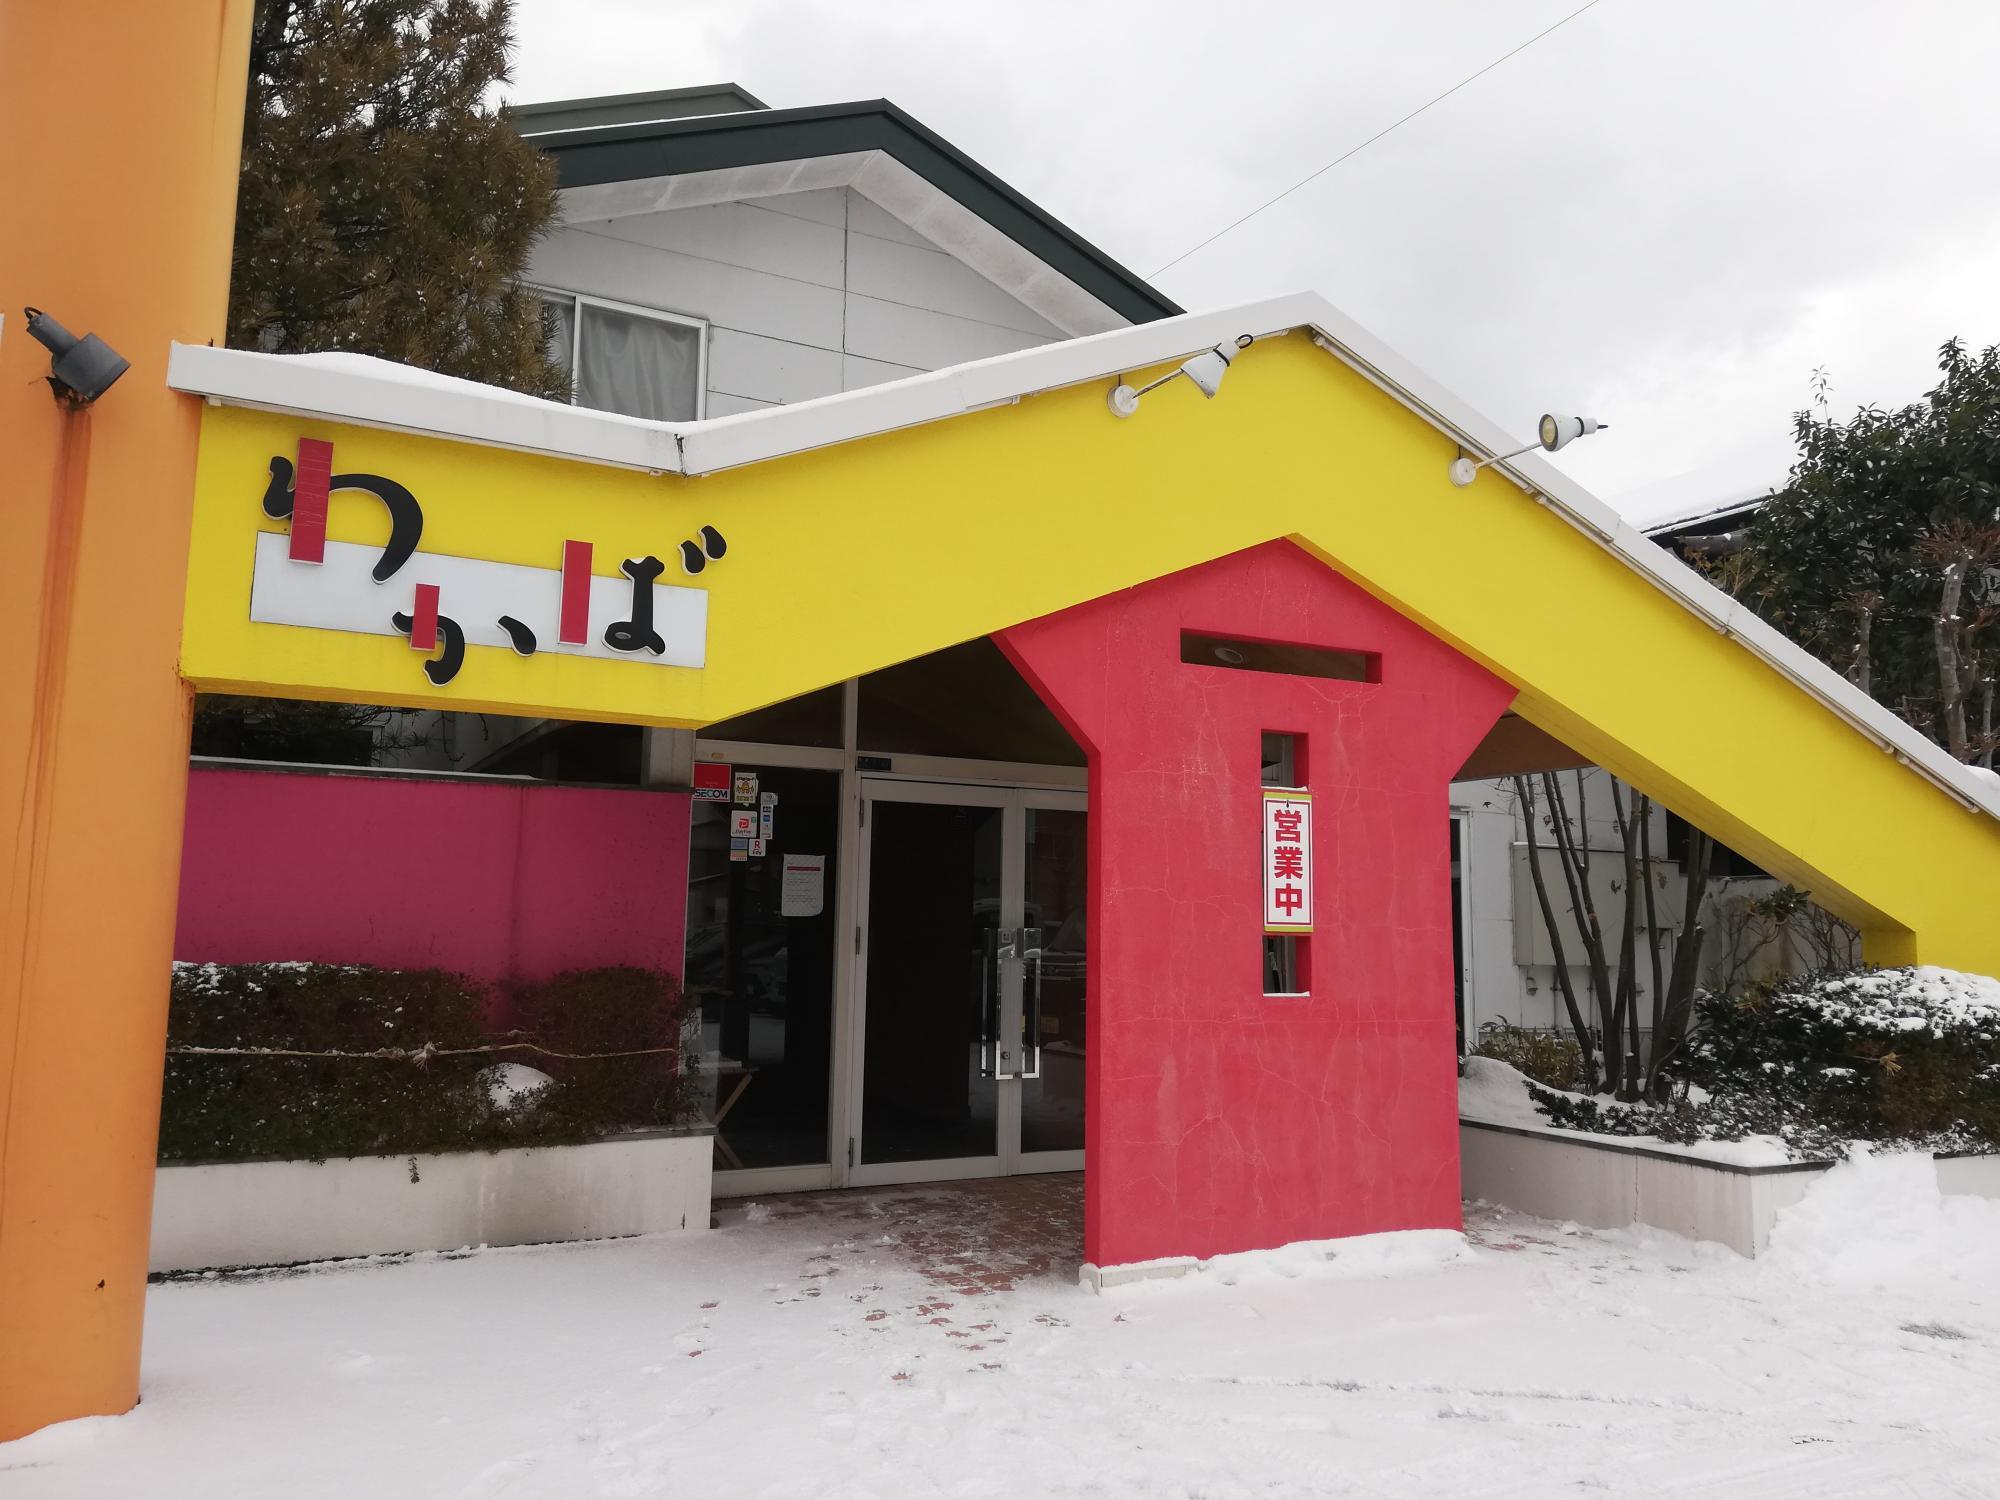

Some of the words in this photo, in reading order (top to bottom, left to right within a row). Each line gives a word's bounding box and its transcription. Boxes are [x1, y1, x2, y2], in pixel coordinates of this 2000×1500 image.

[262, 437, 728, 687] わかば
[694, 789, 728, 799] SECOM
[1273, 809, 1303, 917] 営業中
